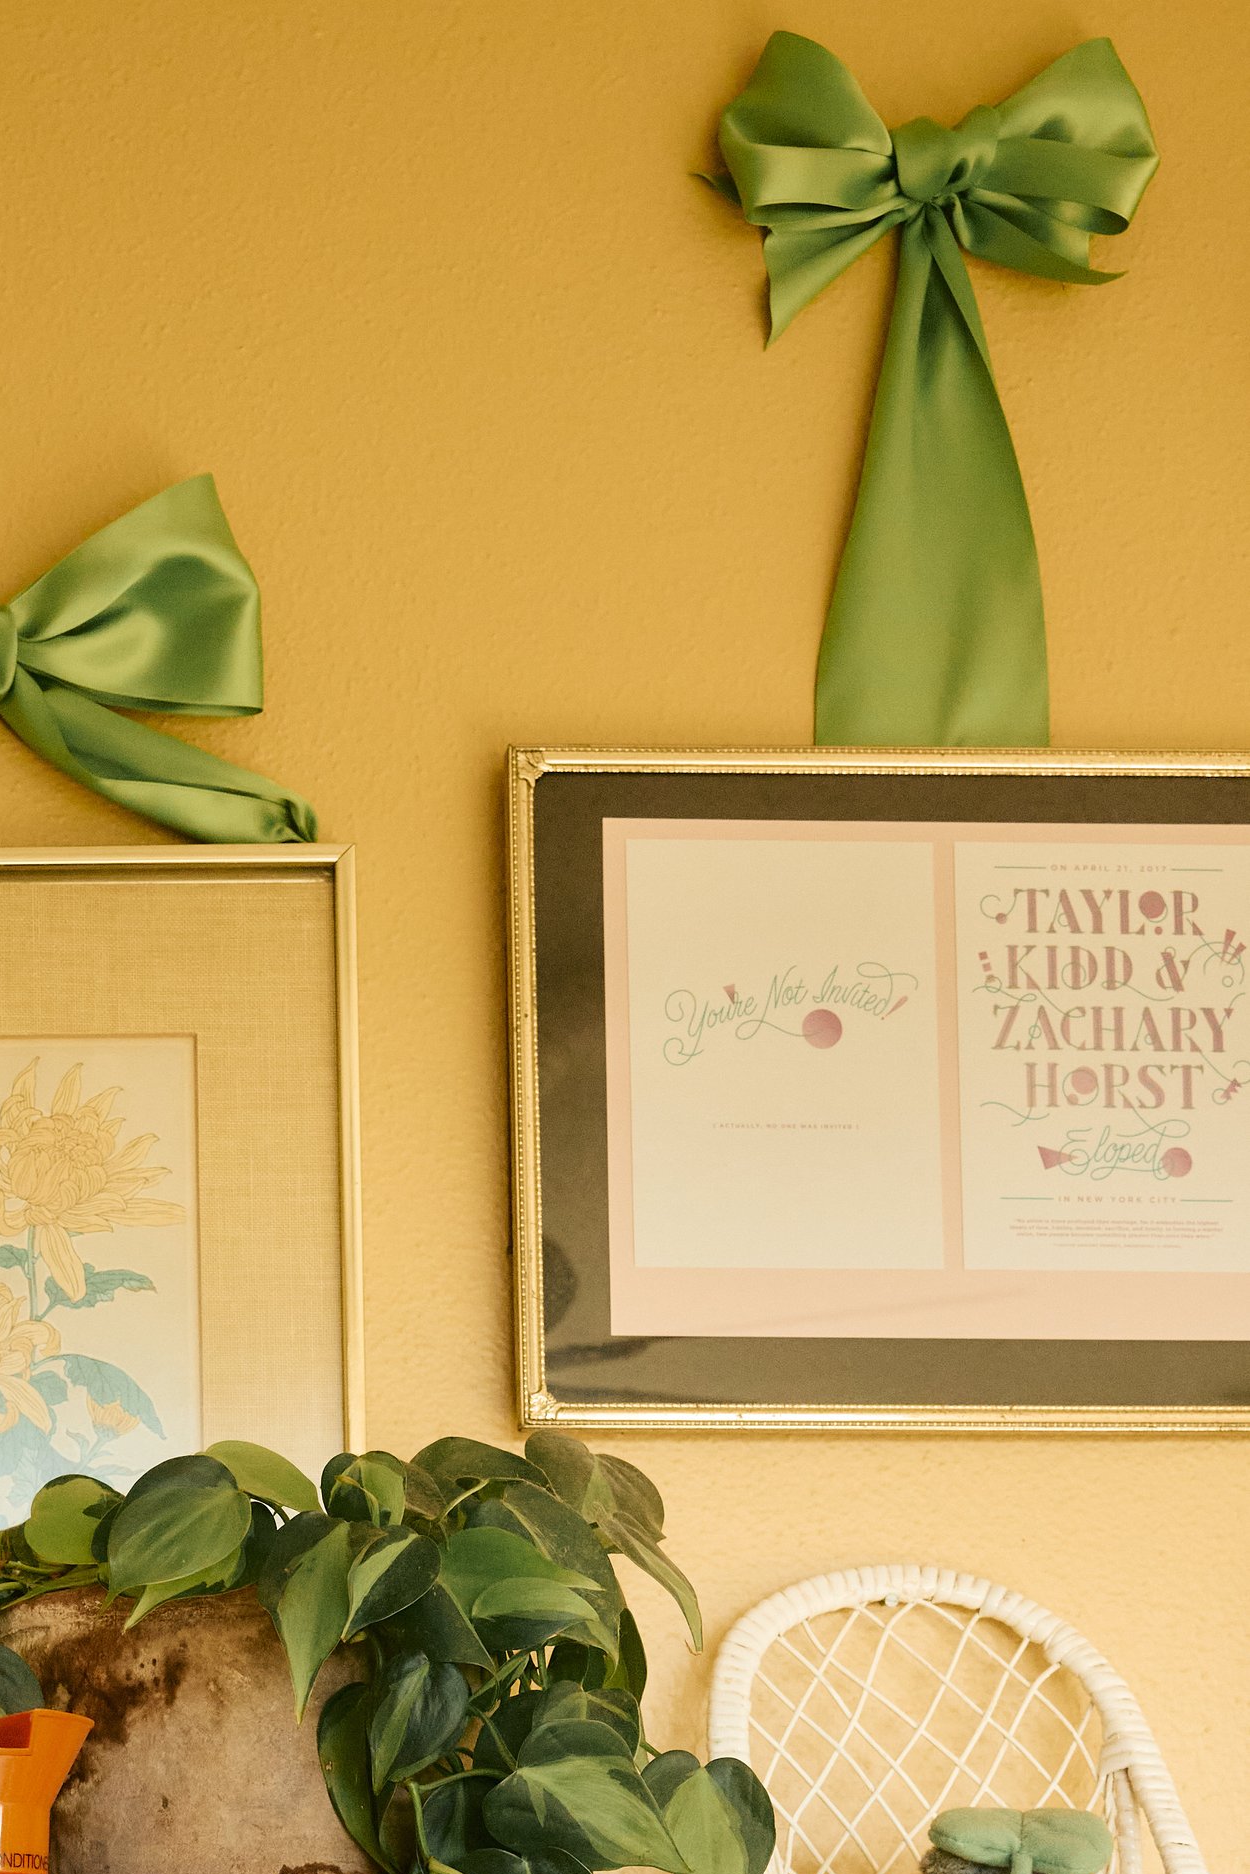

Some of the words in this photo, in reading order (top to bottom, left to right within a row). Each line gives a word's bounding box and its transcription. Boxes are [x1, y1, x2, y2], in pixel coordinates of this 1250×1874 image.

[1050, 864, 1067, 872] ON
[1074, 864, 1110, 873] APRIL
[1013, 888, 1205, 936] TAYLOR
[1006, 944, 1133, 991] KIDD
[1155, 949, 1190, 993] &
[991, 1004, 1234, 1053] ZACHARY
[1025, 1062, 1204, 1110] HORST
[1058, 1120, 1191, 1181] Eloped
[1058, 1195, 1071, 1203] IN
[1077, 1195, 1103, 1203] NEW
[1110, 1195, 1143, 1204] YORK
[1149, 1196, 1177, 1204] CITY
